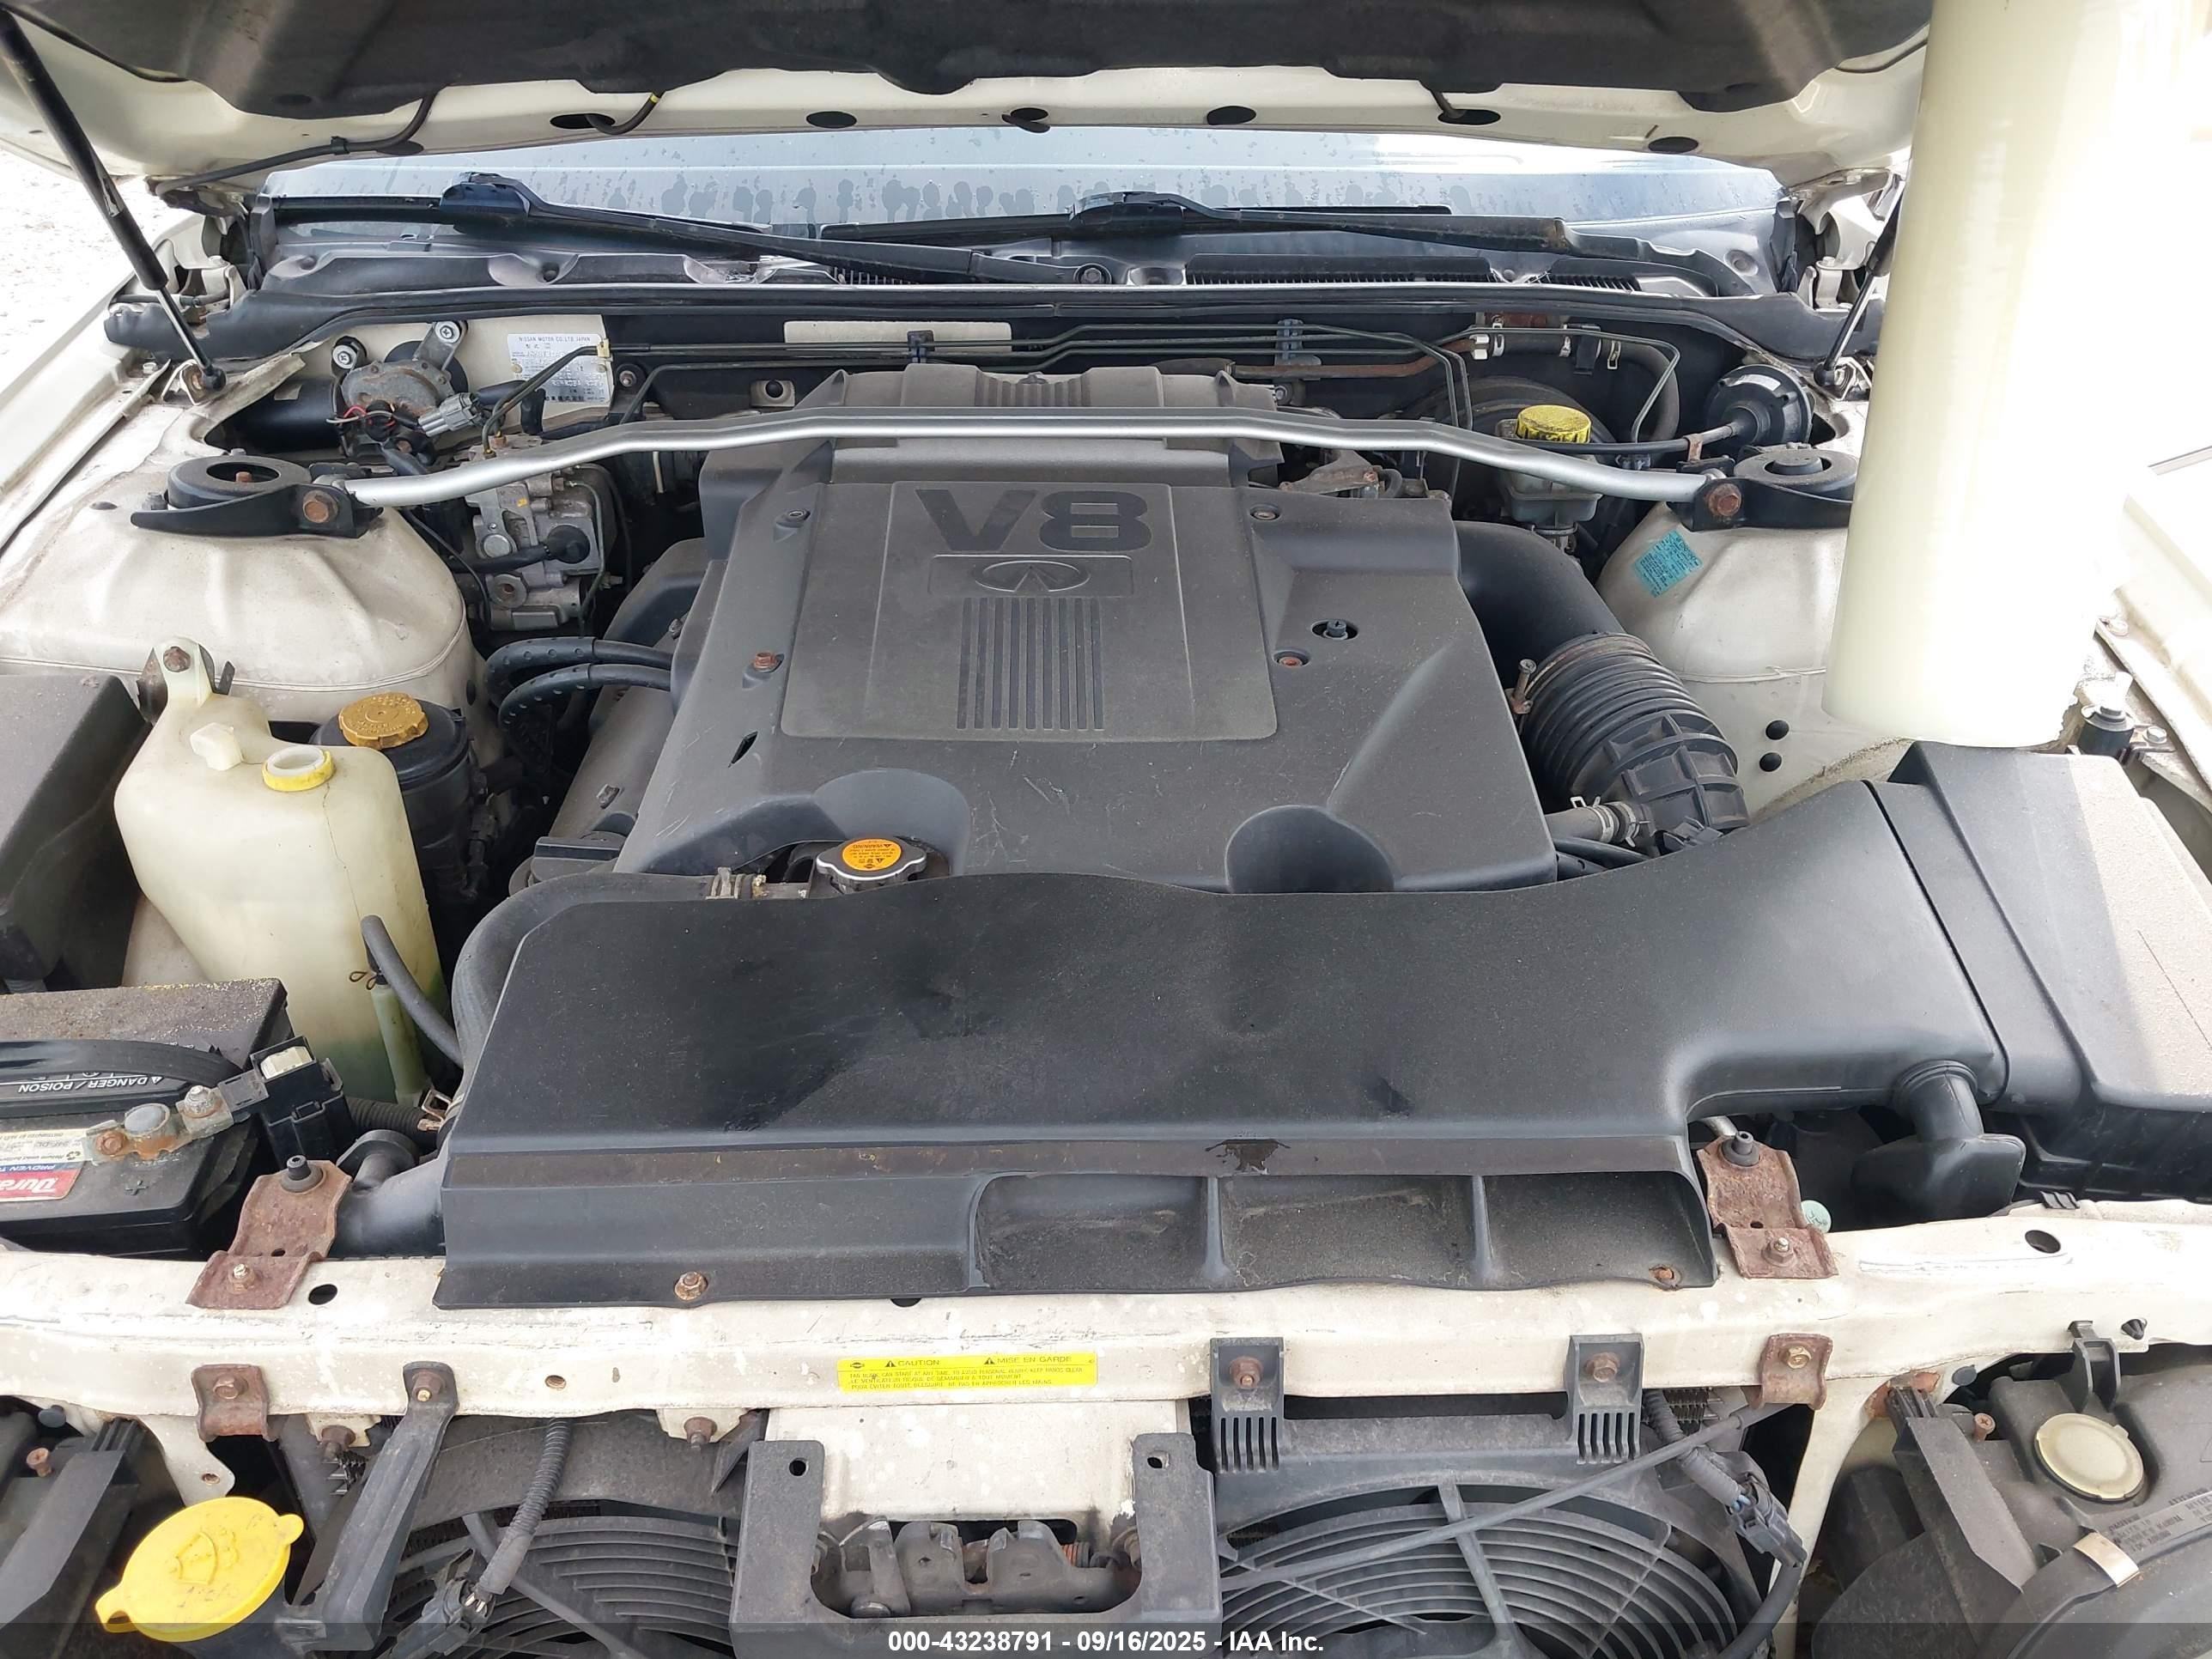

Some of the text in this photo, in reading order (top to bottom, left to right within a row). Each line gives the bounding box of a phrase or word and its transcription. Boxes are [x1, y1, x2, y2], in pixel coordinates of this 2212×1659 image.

[915, 489, 1153, 552] V8
[18, 1081, 74, 1093] POISON
[88, 1076, 149, 1089] DANGER
